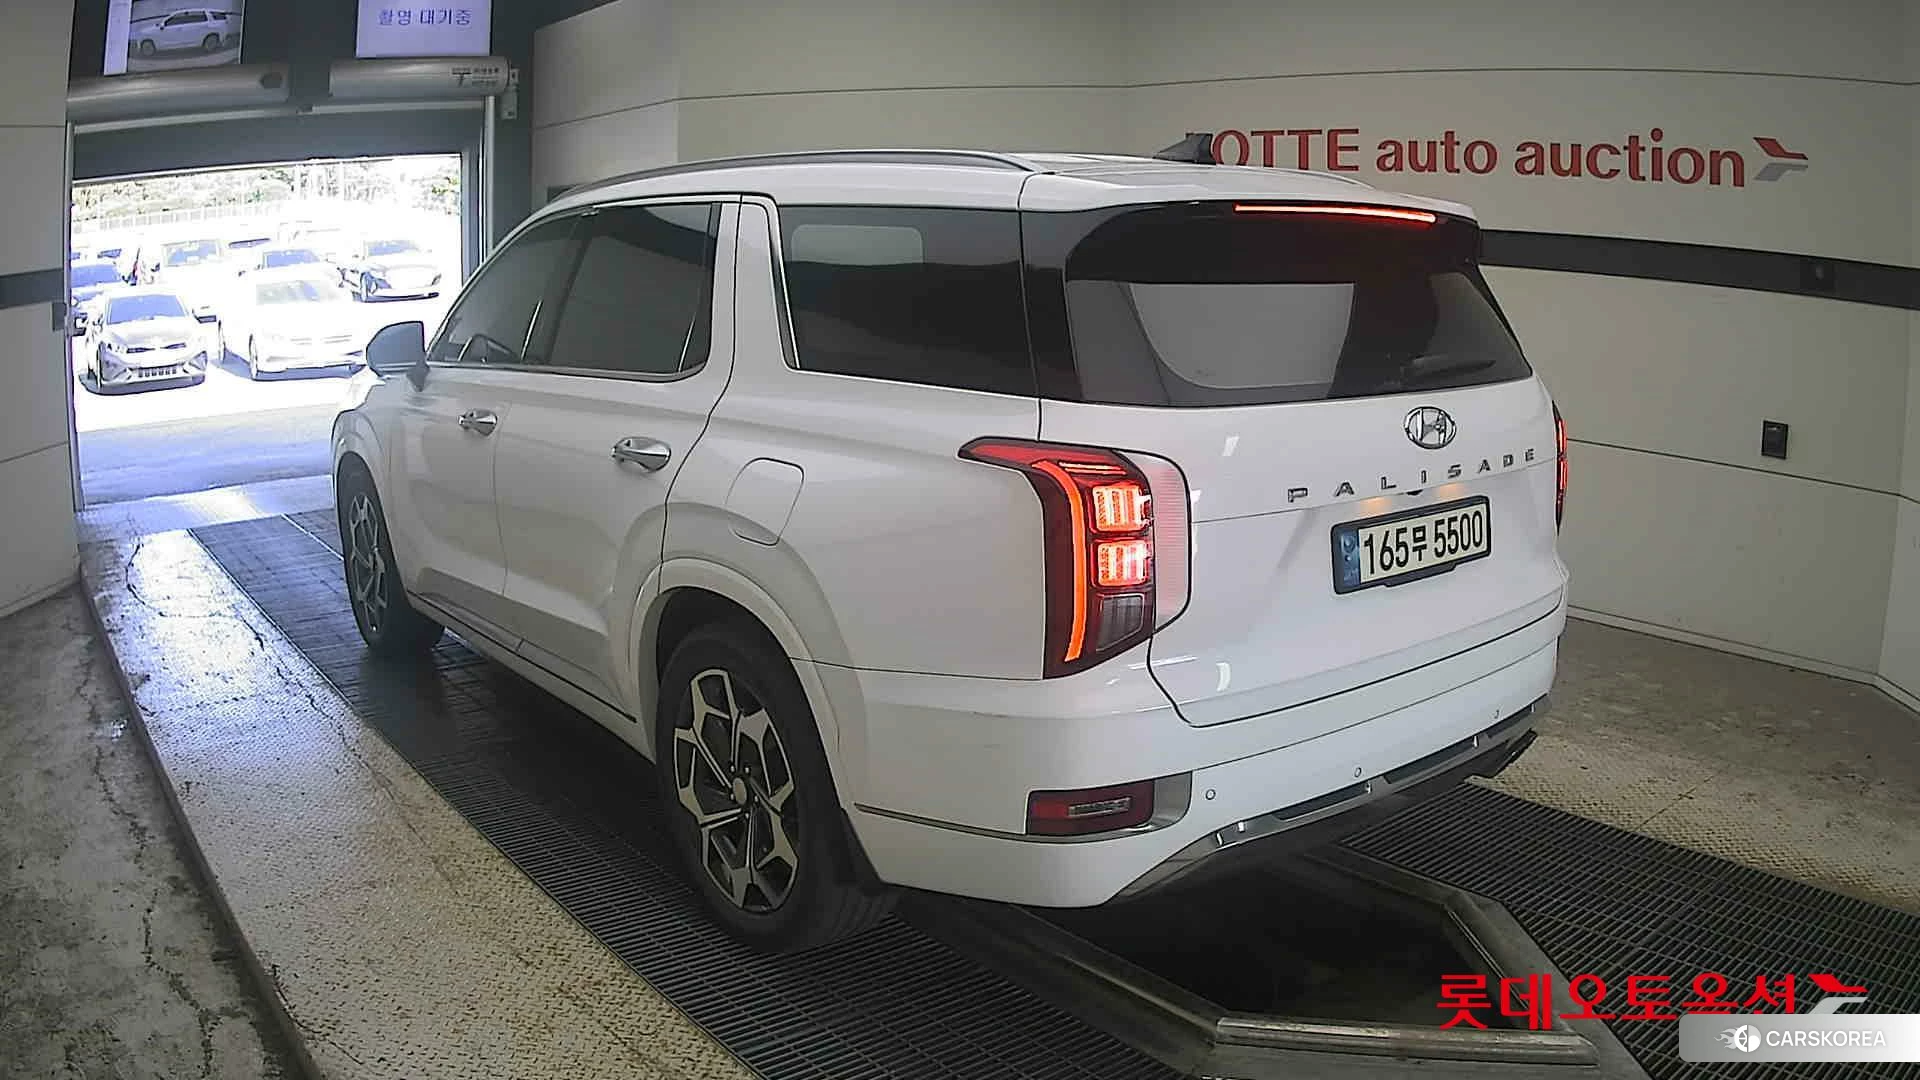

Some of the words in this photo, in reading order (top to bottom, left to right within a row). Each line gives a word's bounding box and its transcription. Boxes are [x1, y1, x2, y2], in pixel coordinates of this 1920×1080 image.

[420, 8, 472, 26] 대기중
[1188, 128, 1359, 171] OTTE
[1376, 131, 1497, 174] auto
[1515, 128, 1745, 187] auction
[1287, 449, 1535, 502] PALISADE
[1363, 525, 1427, 576] 165무
[1434, 510, 1483, 559] 5500
